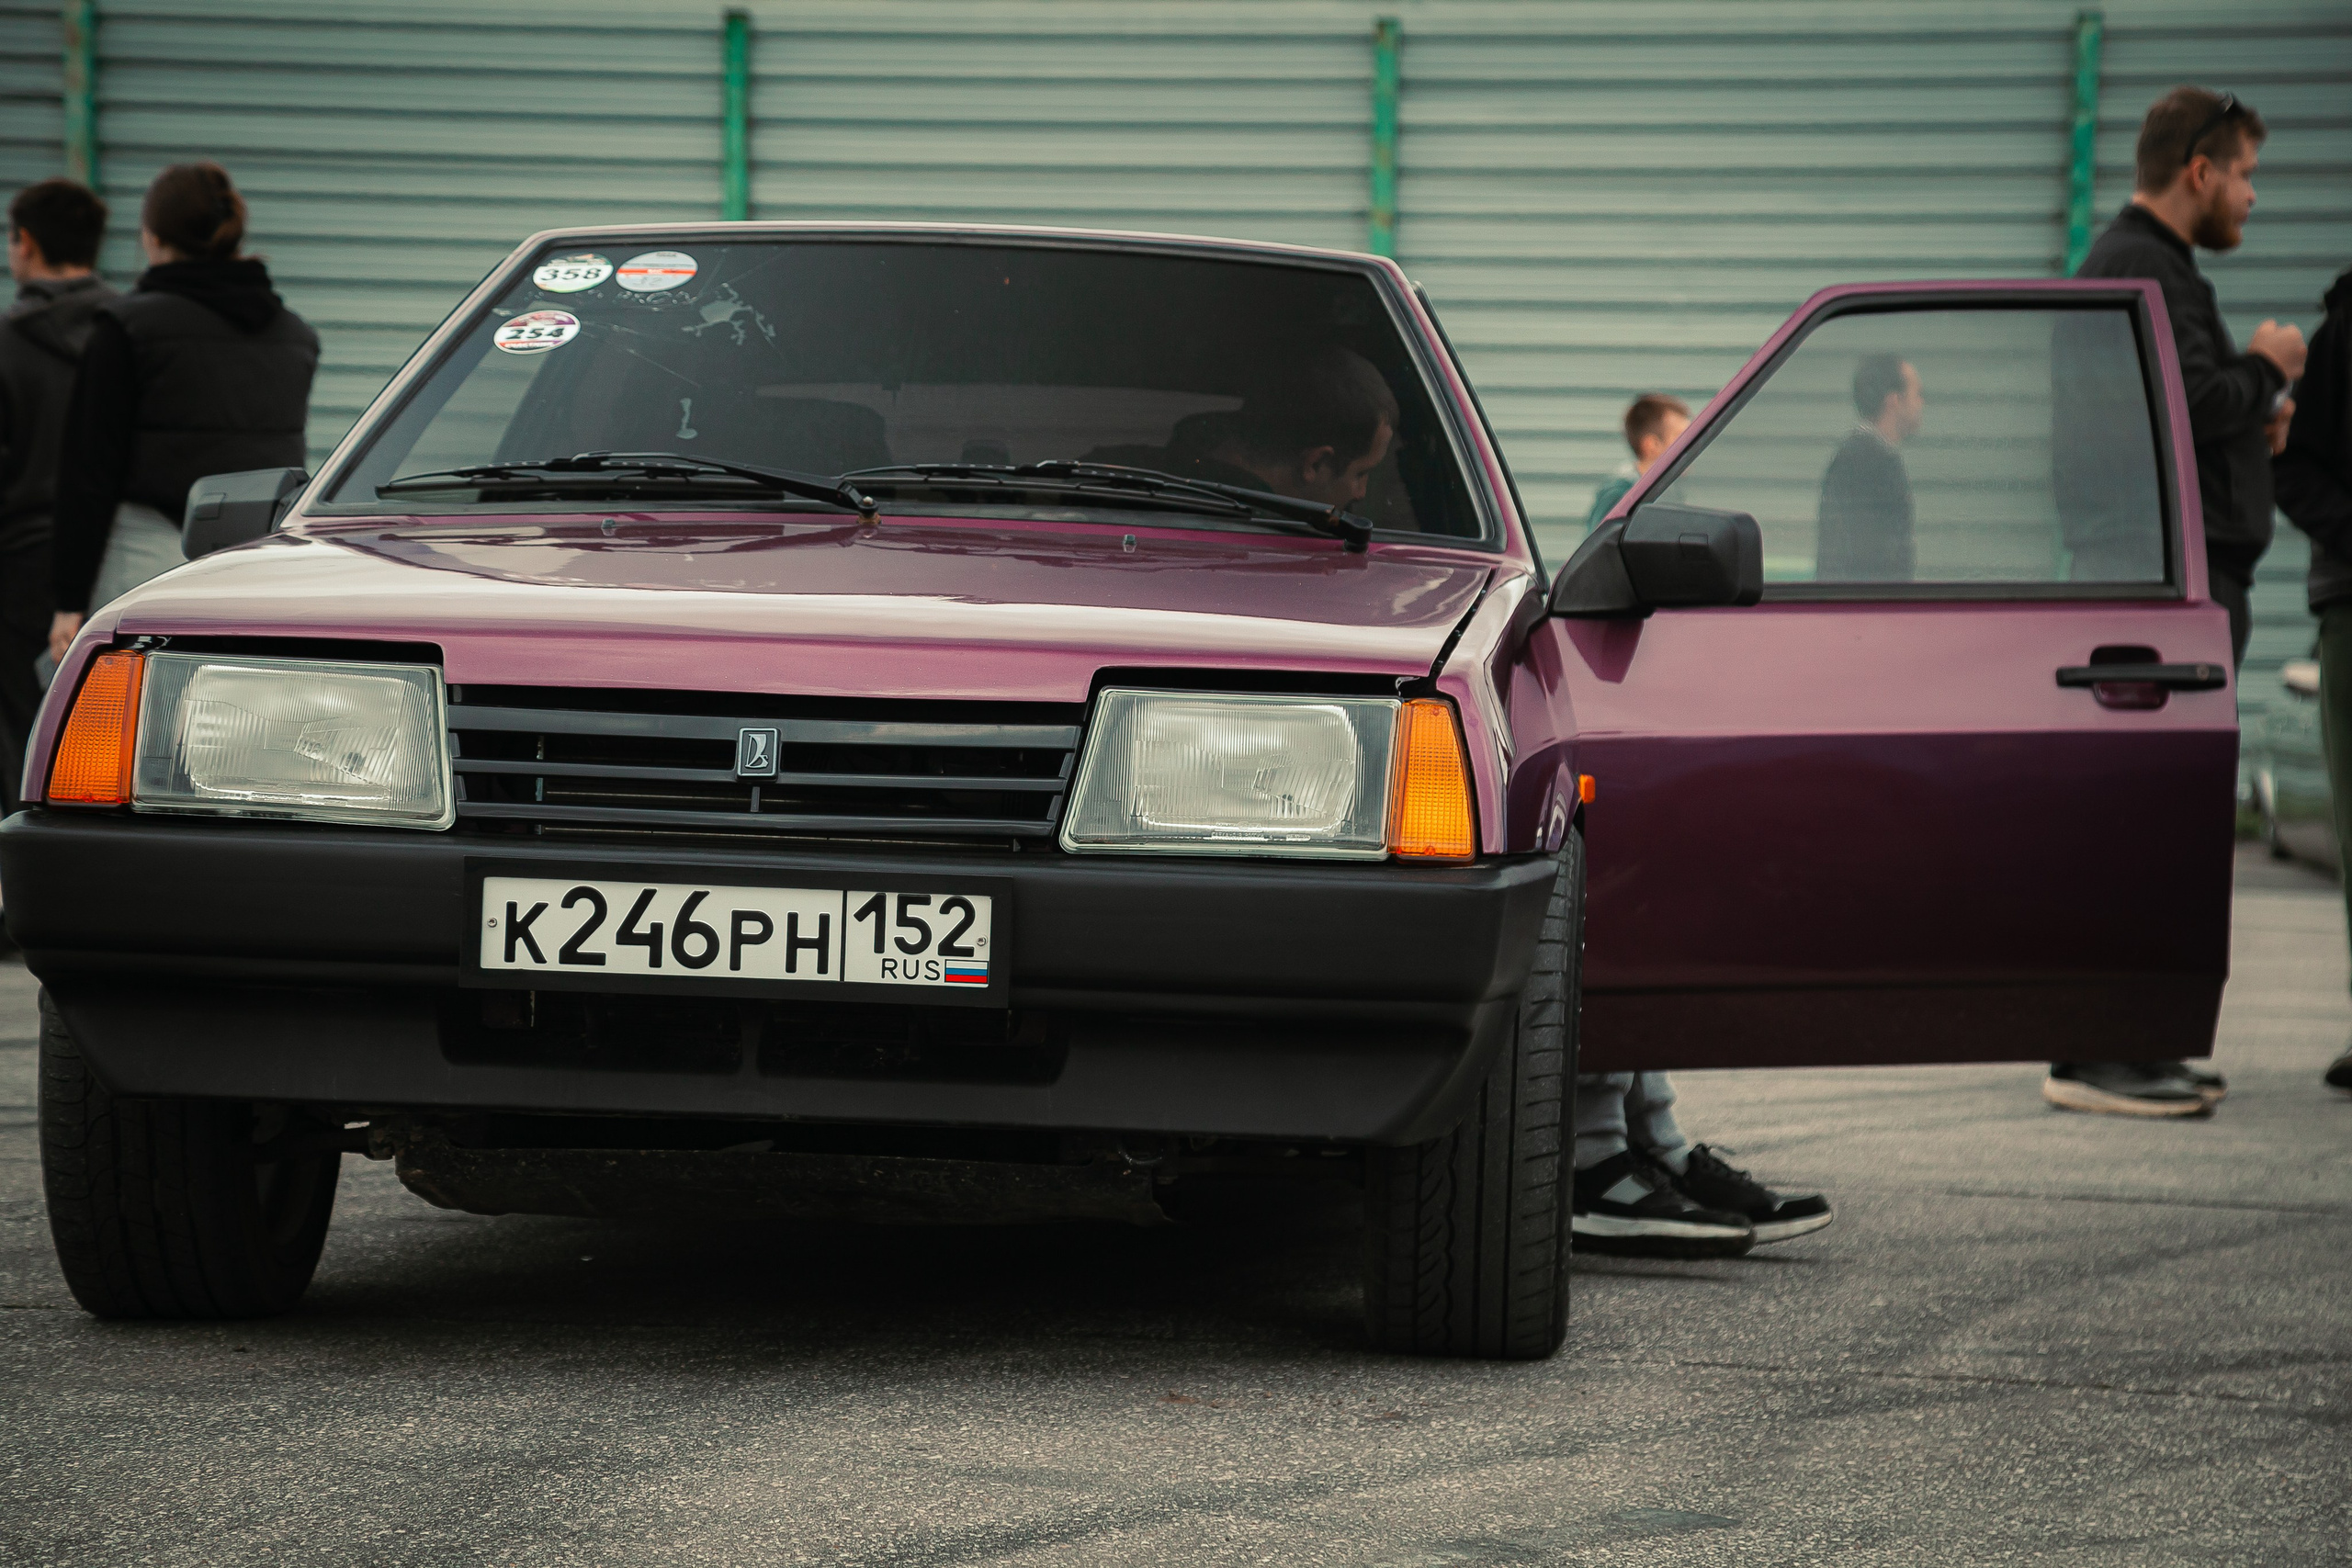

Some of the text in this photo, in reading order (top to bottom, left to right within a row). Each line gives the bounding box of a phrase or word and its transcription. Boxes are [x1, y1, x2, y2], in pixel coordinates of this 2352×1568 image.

[540, 267, 602, 281] 358
[505, 327, 565, 340] 254
[854, 892, 976, 958] 152
[880, 957, 942, 981] RUS
